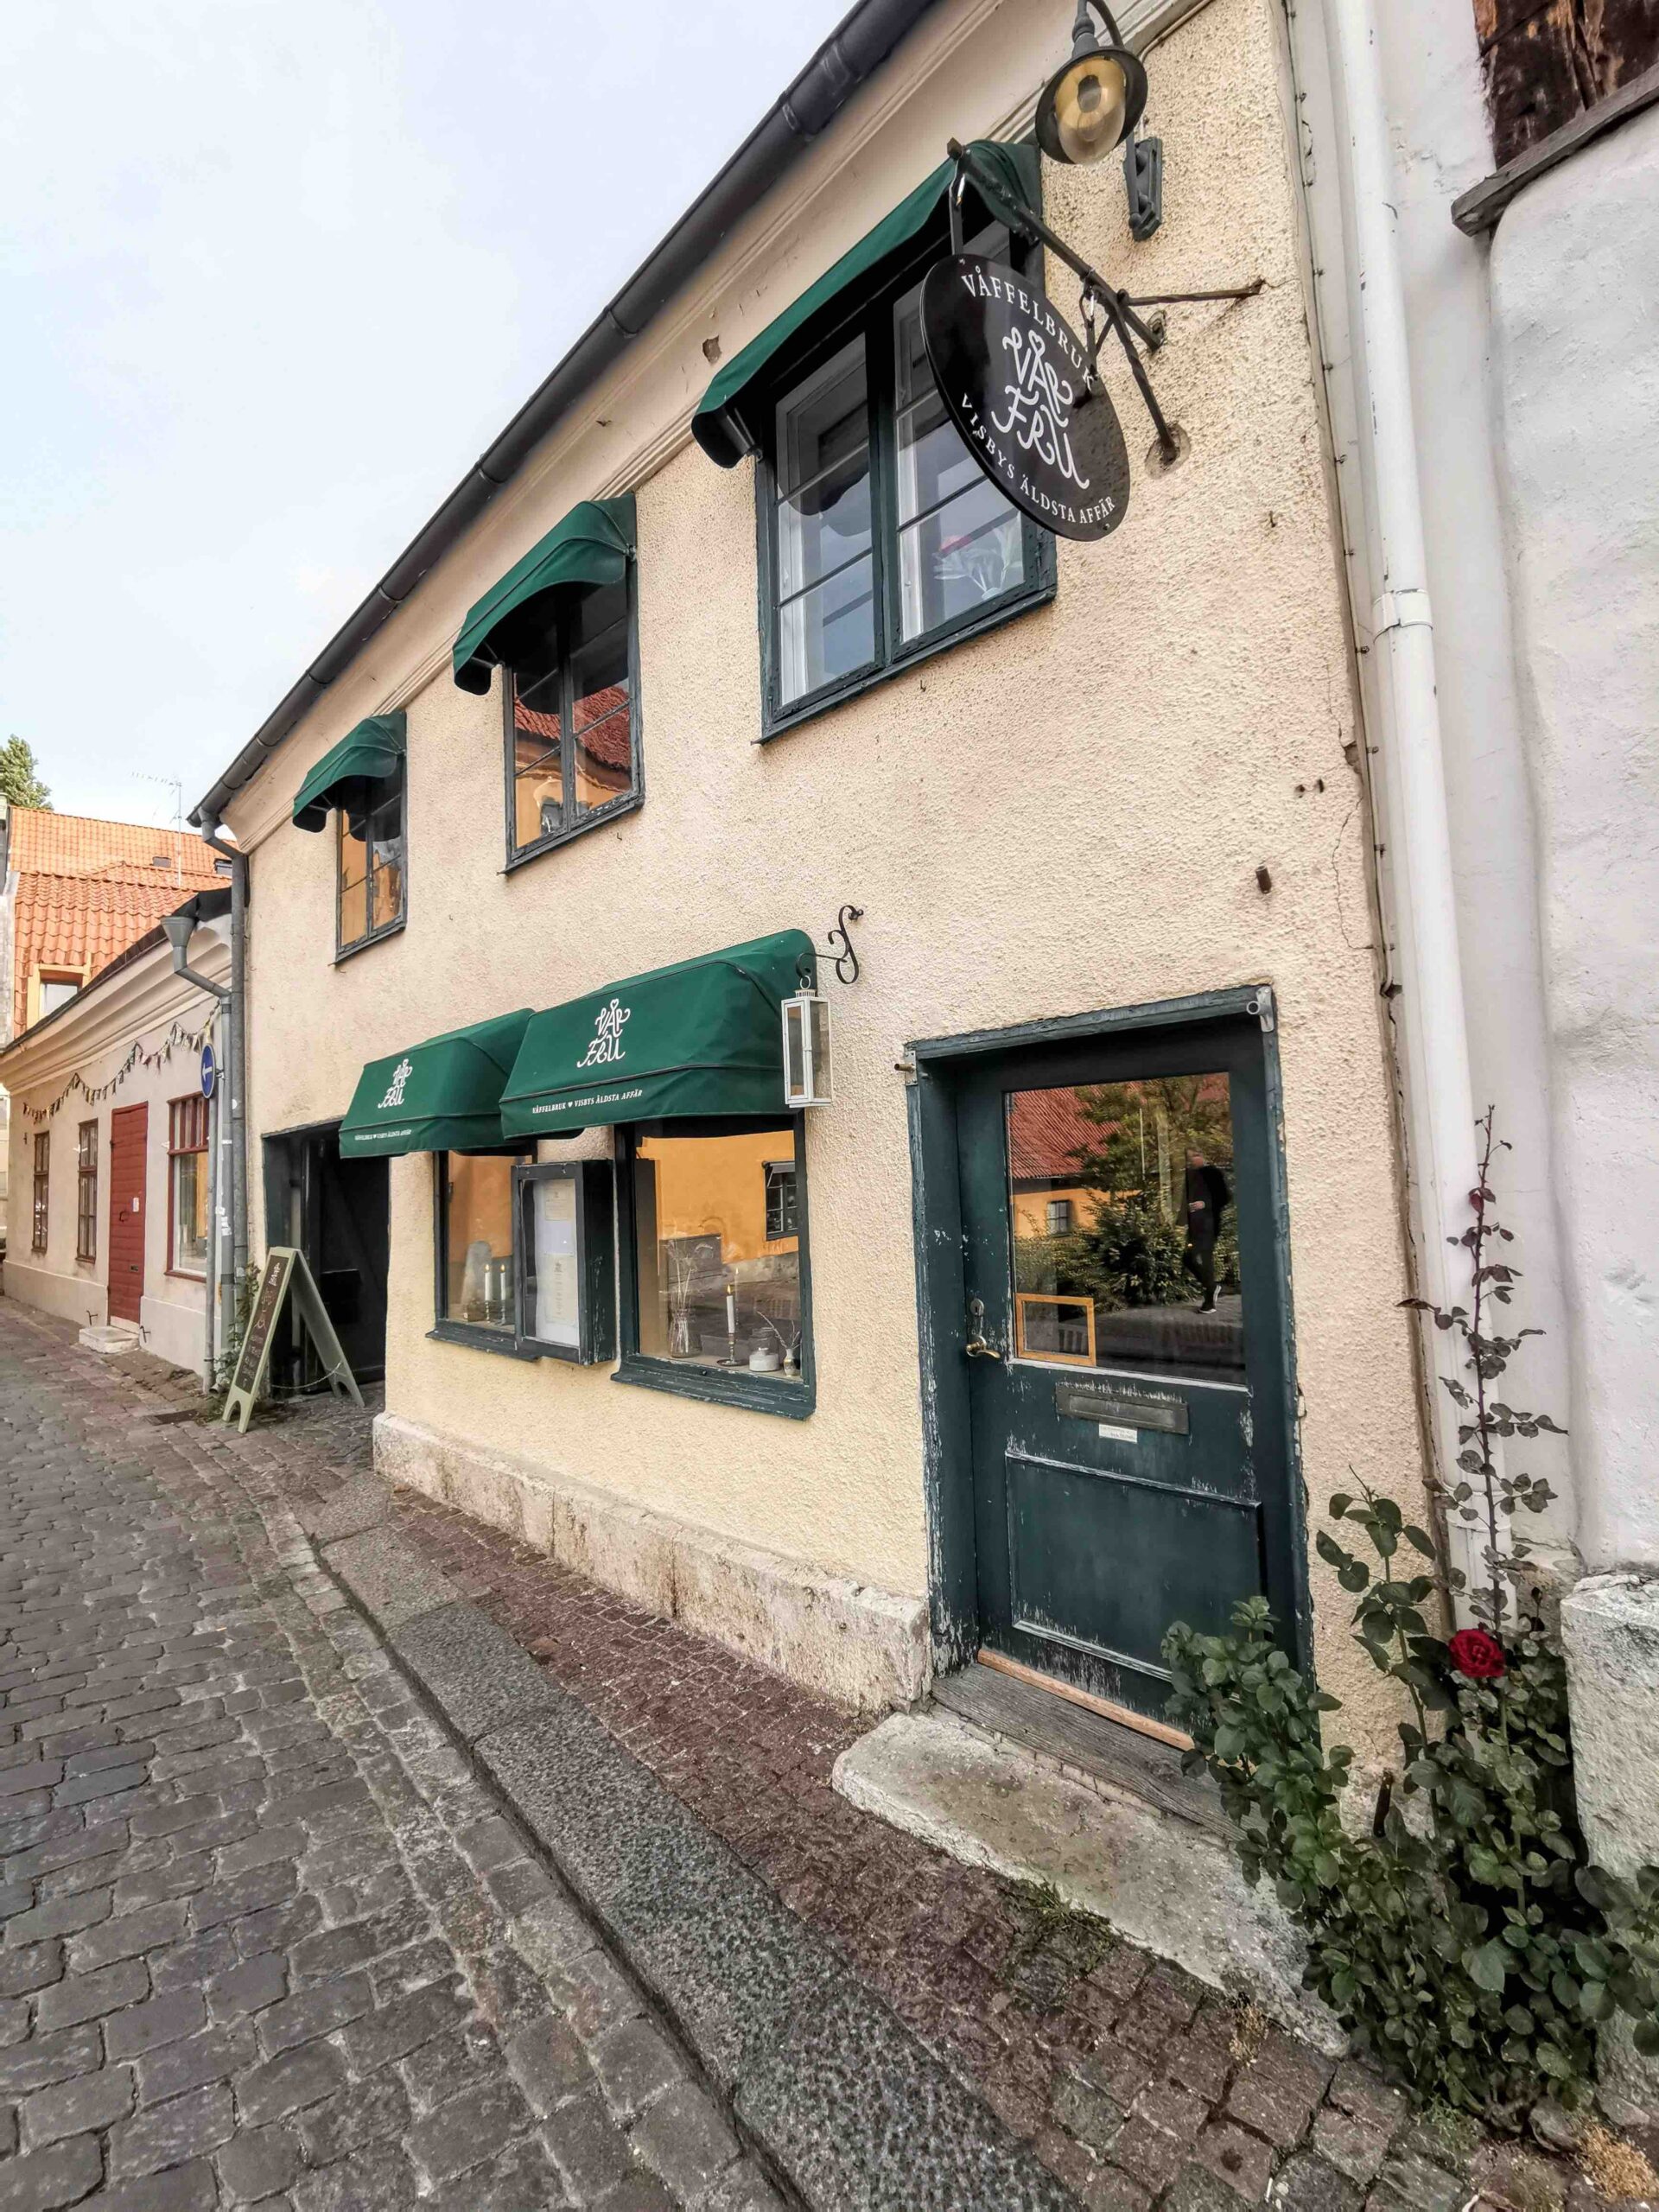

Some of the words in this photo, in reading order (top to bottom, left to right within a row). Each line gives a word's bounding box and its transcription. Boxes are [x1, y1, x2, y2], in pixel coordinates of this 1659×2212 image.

[961, 265, 1096, 391] VÅFFELBRUK
[961, 393, 1015, 479] VISBYS
[1020, 474, 1076, 524] ÄLDSTA
[1079, 495, 1116, 524] AFFÄR
[575, 1097, 594, 1107] VISBYS
